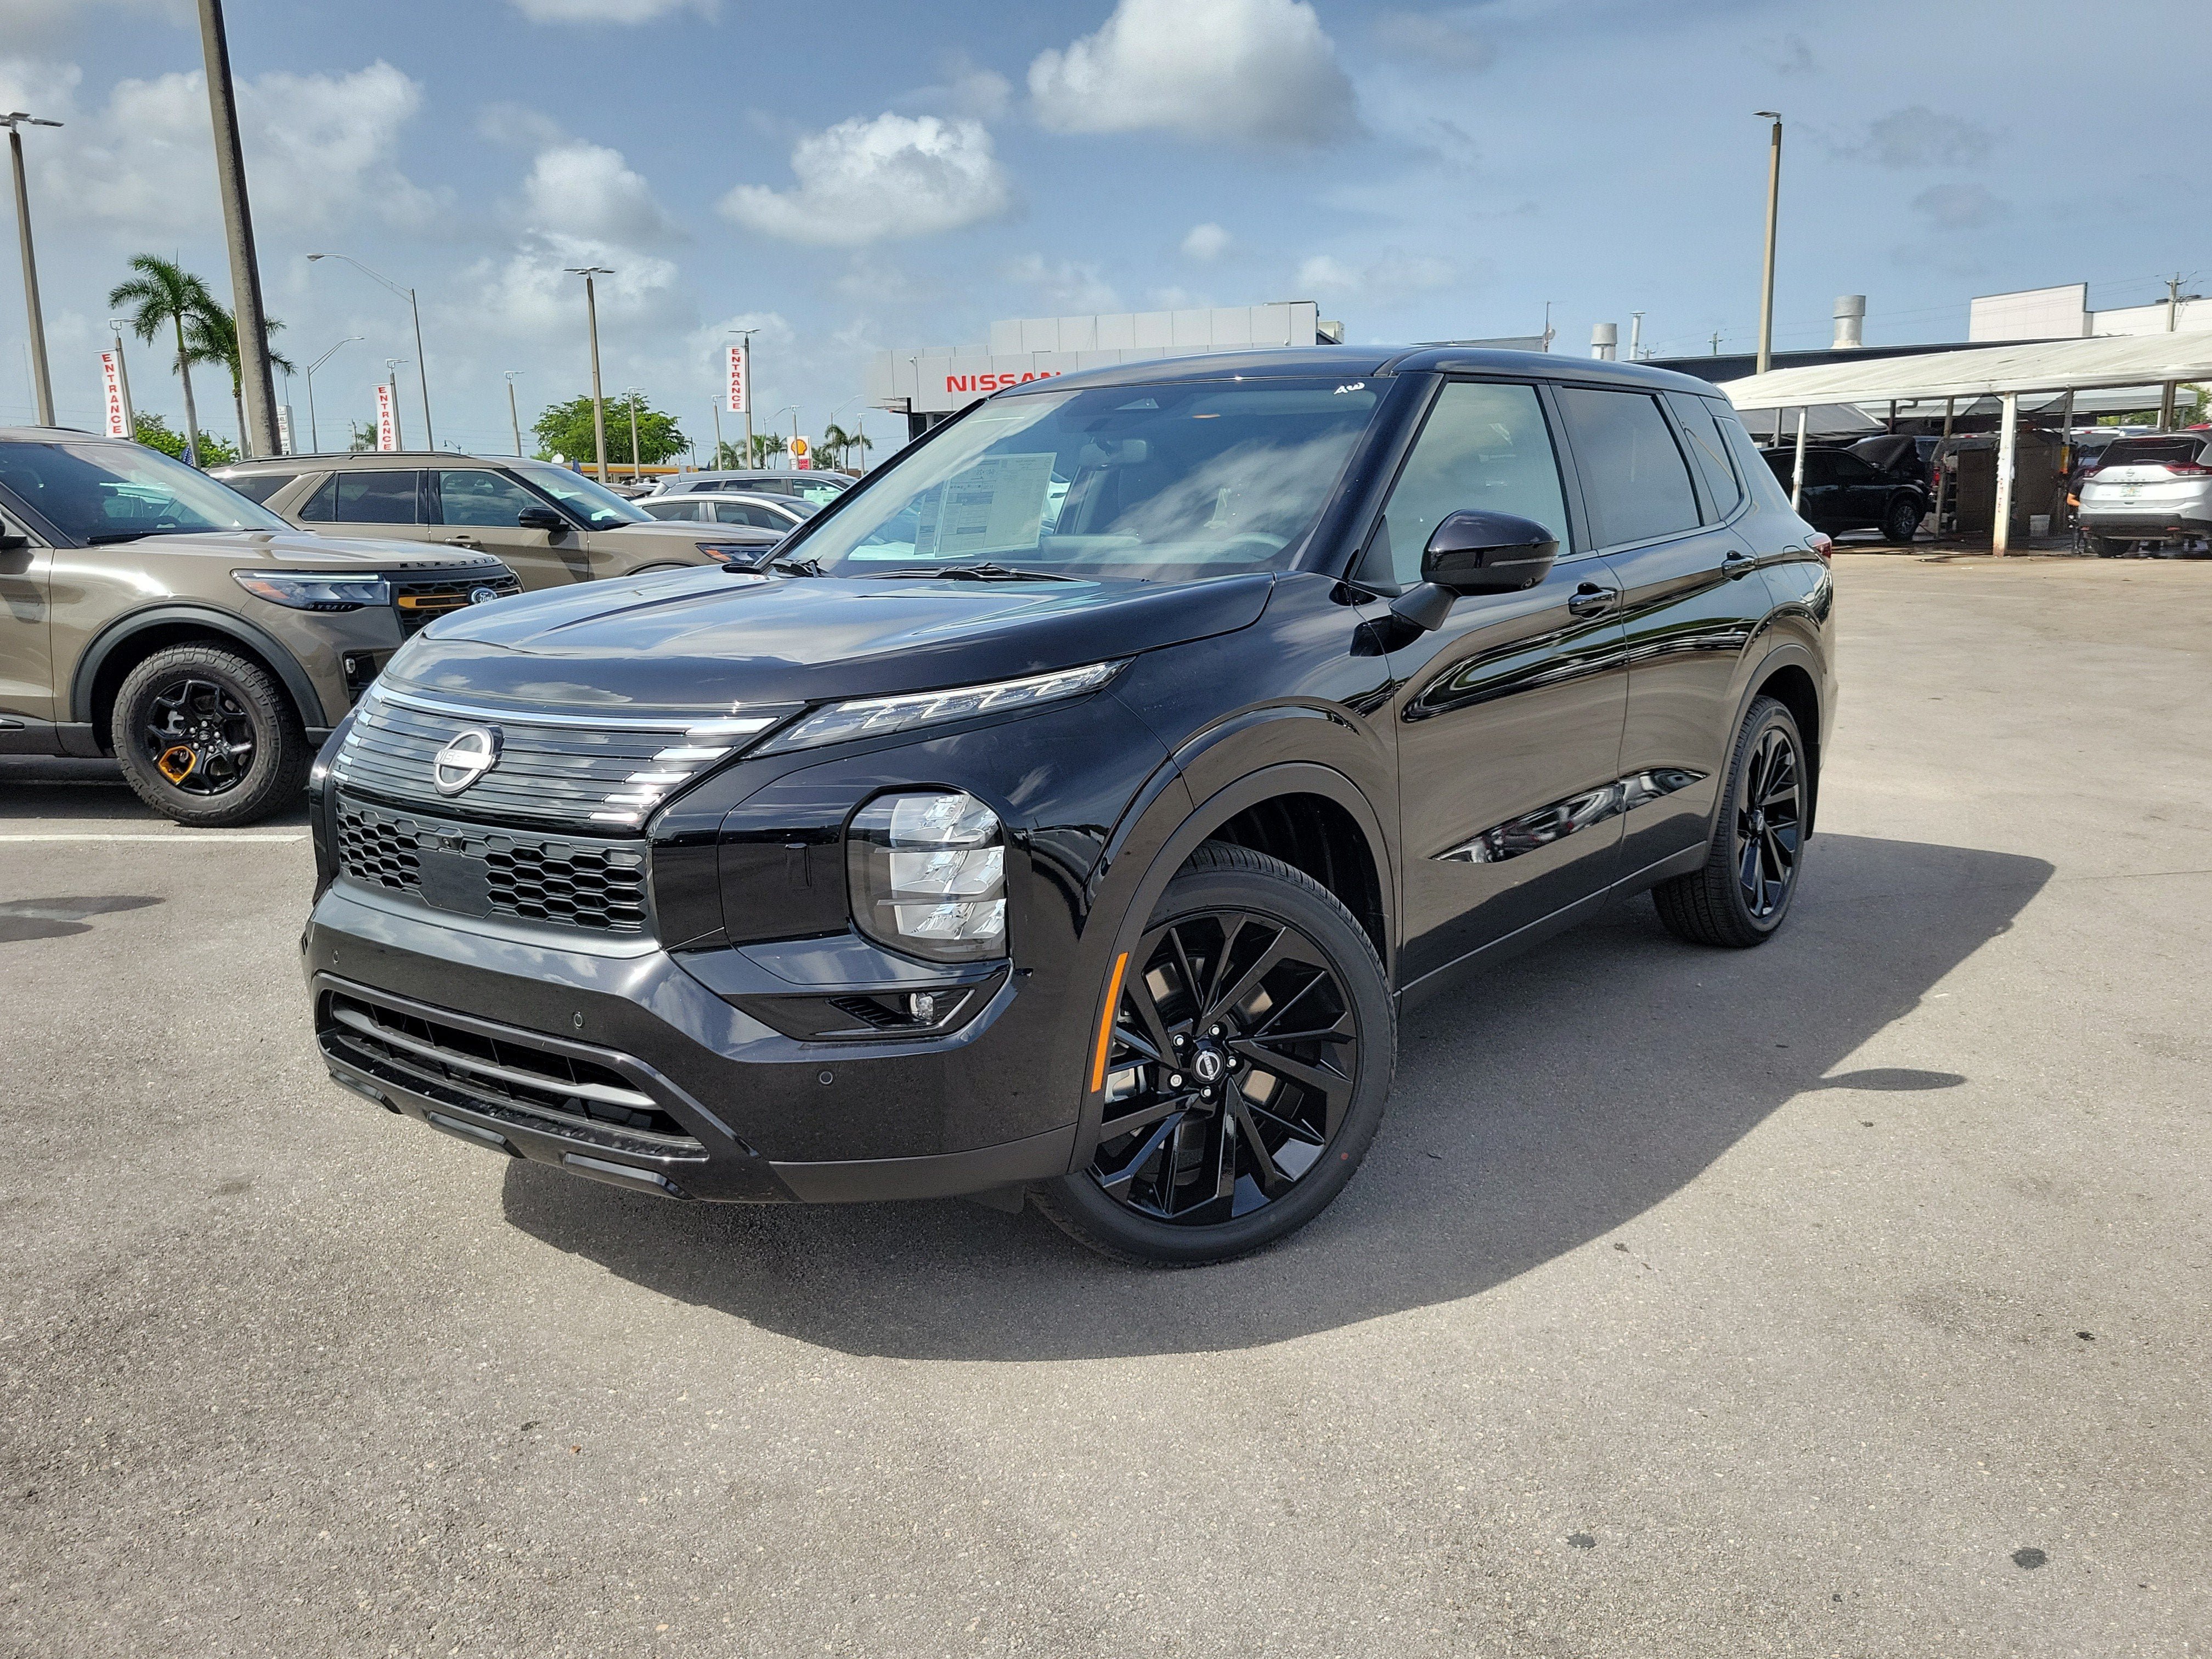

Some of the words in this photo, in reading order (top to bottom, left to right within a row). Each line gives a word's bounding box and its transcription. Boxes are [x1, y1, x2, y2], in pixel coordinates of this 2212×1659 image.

[102, 354, 122, 433] ENTRANCE
[732, 348, 741, 409] ENTRANCE
[378, 387, 392, 450] ENTRANCE
[435, 749, 492, 770] NISS
